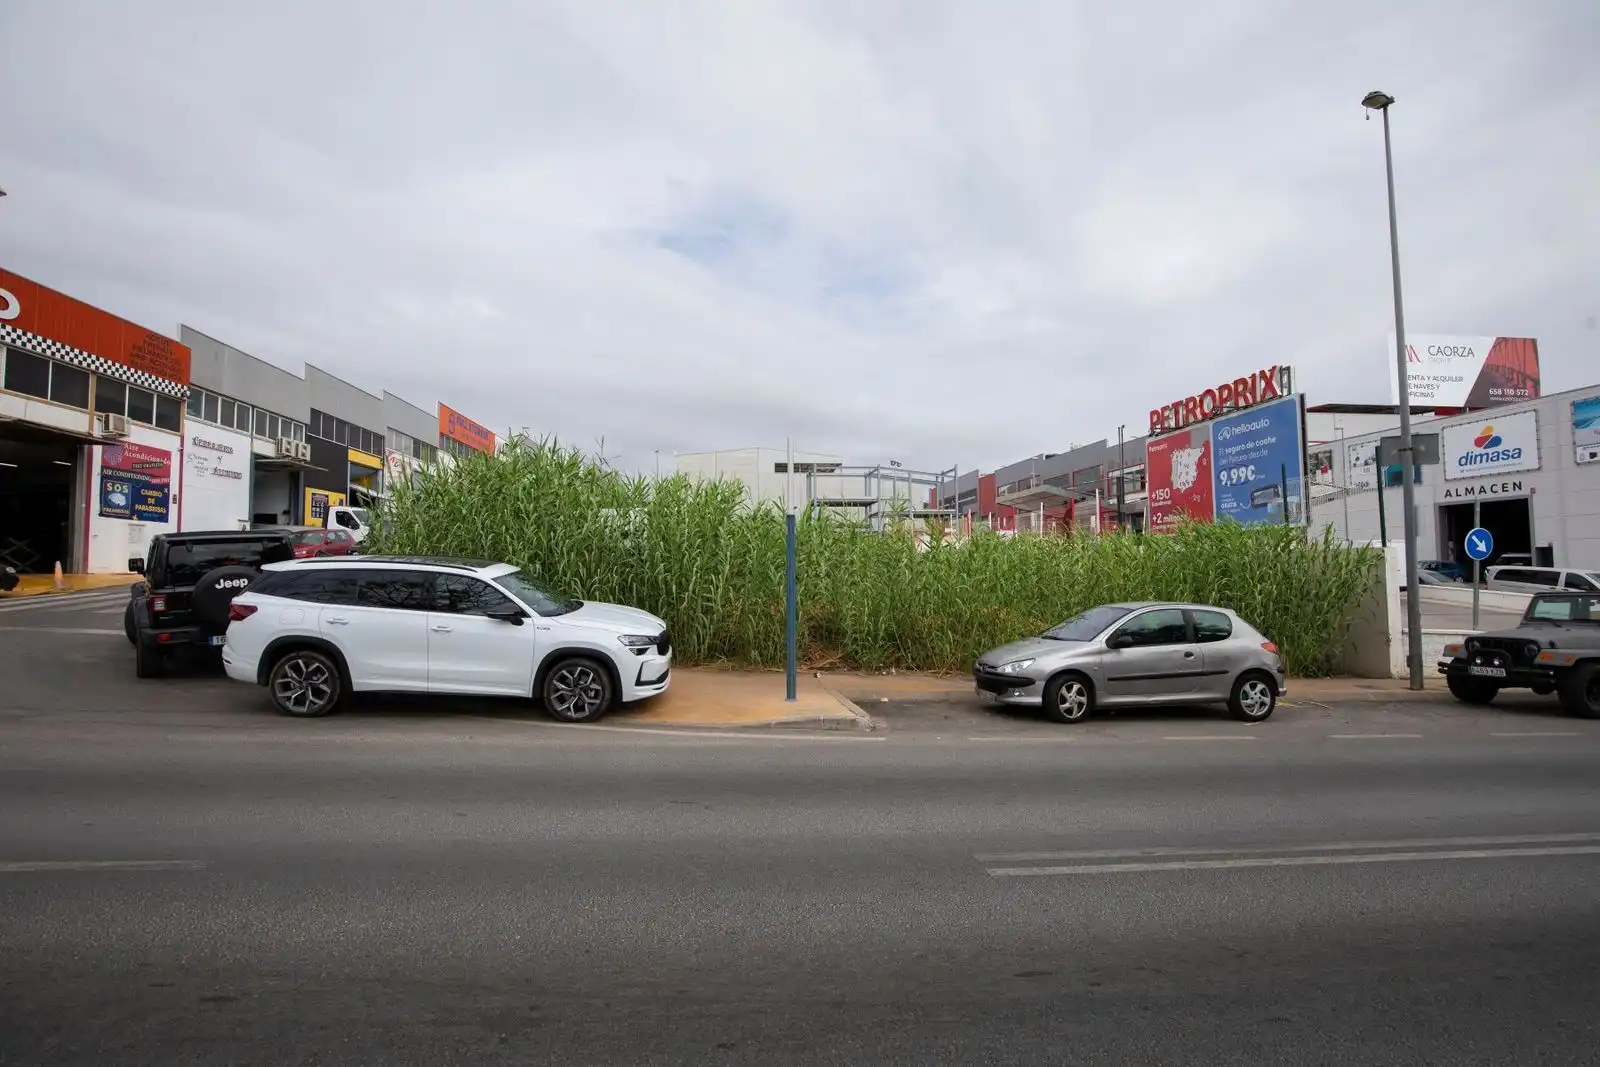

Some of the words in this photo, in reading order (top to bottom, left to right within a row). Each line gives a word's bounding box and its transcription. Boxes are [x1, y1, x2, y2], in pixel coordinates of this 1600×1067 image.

[1427, 345, 1475, 358] CAORZA
[1149, 365, 1280, 432] PETROPRIX
[1231, 418, 1270, 436] helloauto
[123, 442, 139, 452] Aire
[1225, 444, 1246, 455] seguro
[1246, 441, 1255, 449] de
[1255, 436, 1277, 447] coche
[1458, 447, 1522, 467] dimasa
[1220, 465, 1256, 487] 9,99€
[106, 482, 129, 493] SOS
[1151, 488, 1171, 500] +150
[1445, 480, 1523, 499] ALMACEN
[1152, 512, 1162, 523] +2
[215, 578, 248, 589] Jeep
